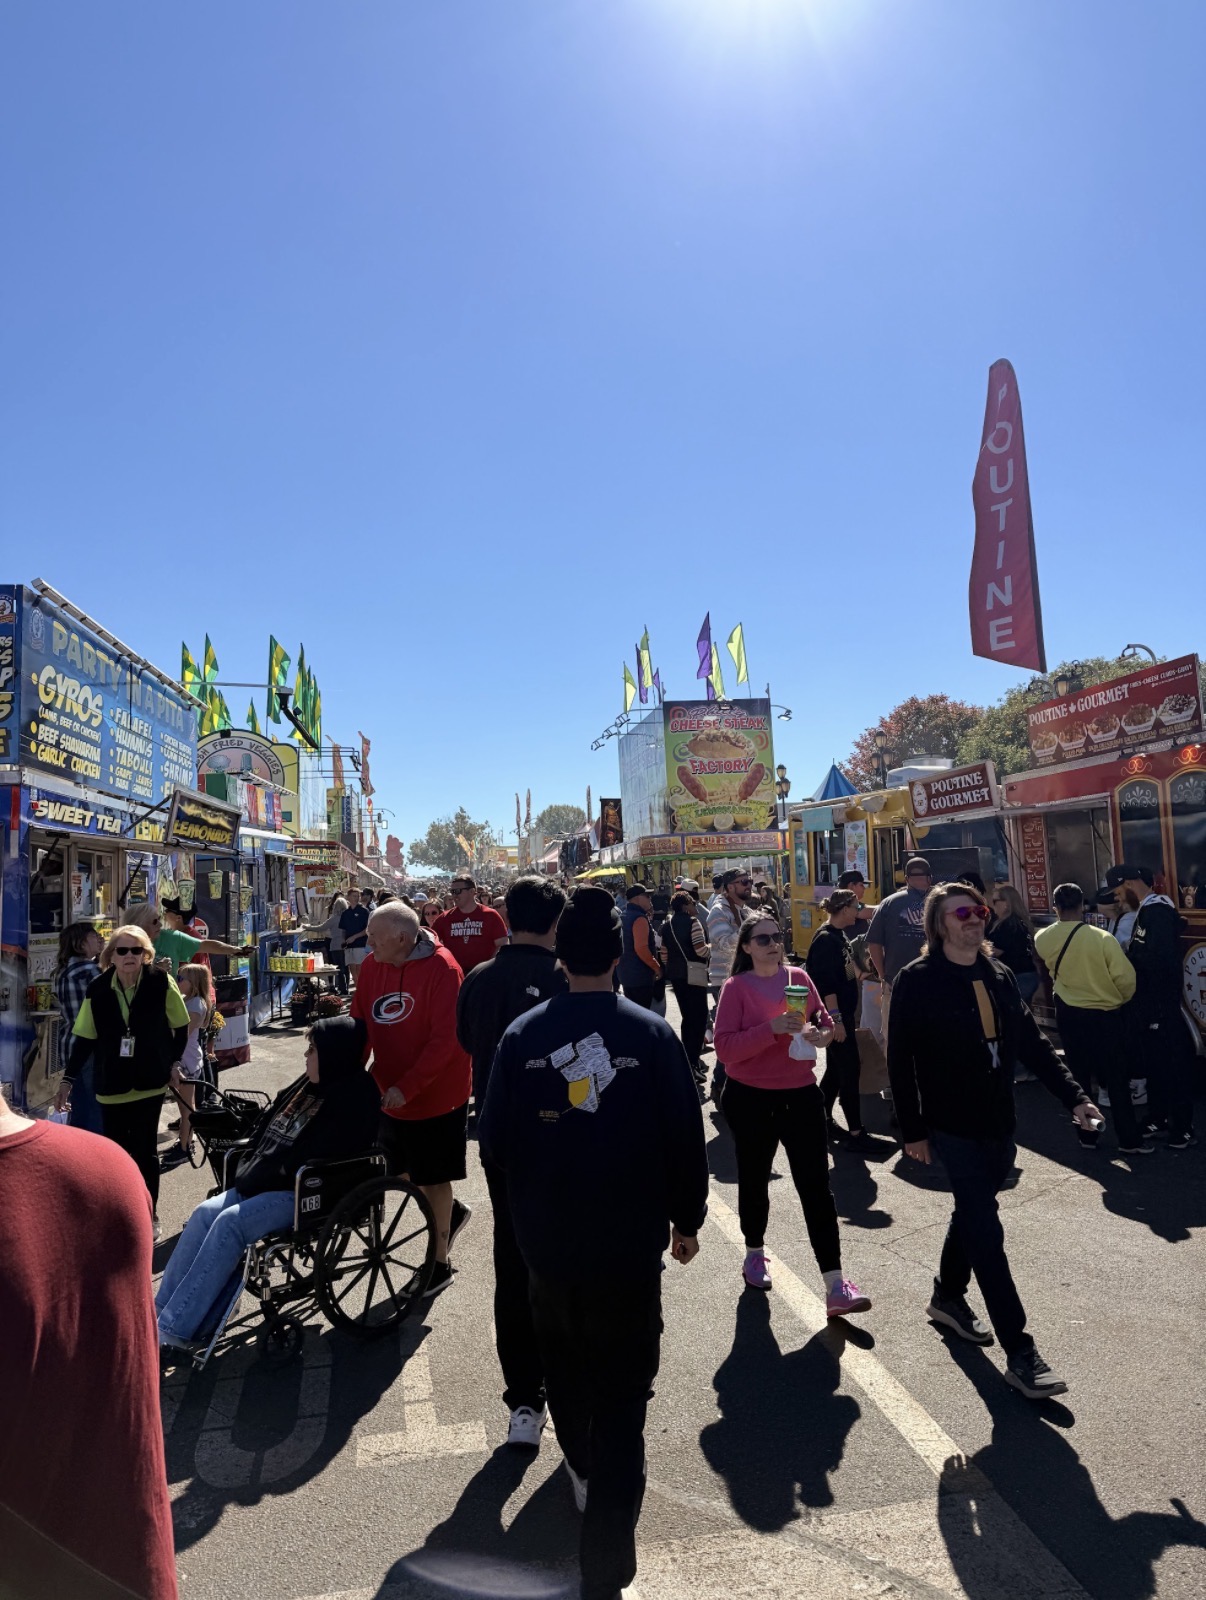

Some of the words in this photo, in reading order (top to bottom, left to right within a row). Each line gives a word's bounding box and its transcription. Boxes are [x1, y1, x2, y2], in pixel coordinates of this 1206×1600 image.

[52, 620, 121, 692] PARTY
[126, 670, 142, 707] IN
[145, 685, 154, 715] A
[157, 692, 184, 732] PITA
[38, 664, 103, 727] GYROS
[1028, 703, 1068, 727] POUTINE
[1076, 683, 1130, 713] GOURMET
[37, 723, 59, 745] BEEF
[60, 716, 73, 729] BEEF
[73, 721, 80, 732] OR
[115, 707, 152, 740] FALAFEL
[670, 717, 721, 733] CHEESE
[724, 717, 768, 731] STEAK
[37, 744, 67, 768] GARLIC
[71, 756, 101, 779] CHICKEN
[116, 747, 153, 776] TABOULI
[163, 745, 178, 762] CORN
[178, 751, 192, 769] DOGS
[212, 739, 243, 750] FRIED
[249, 741, 281, 775] VEGGIES
[689, 757, 755, 774] FACTORY
[115, 766, 132, 780] GRAPE
[163, 760, 193, 787] SHRIMP
[930, 771, 984, 794] POUTINE
[930, 787, 990, 811] GOURMET
[34, 800, 94, 827] SWEET
[97, 814, 122, 834] TEA
[173, 819, 233, 844] LEMONADE
[691, 833, 776, 845] BURGERS
[450, 928, 482, 937] FOOTBALL
[451, 921, 483, 930] WOLFPACK
